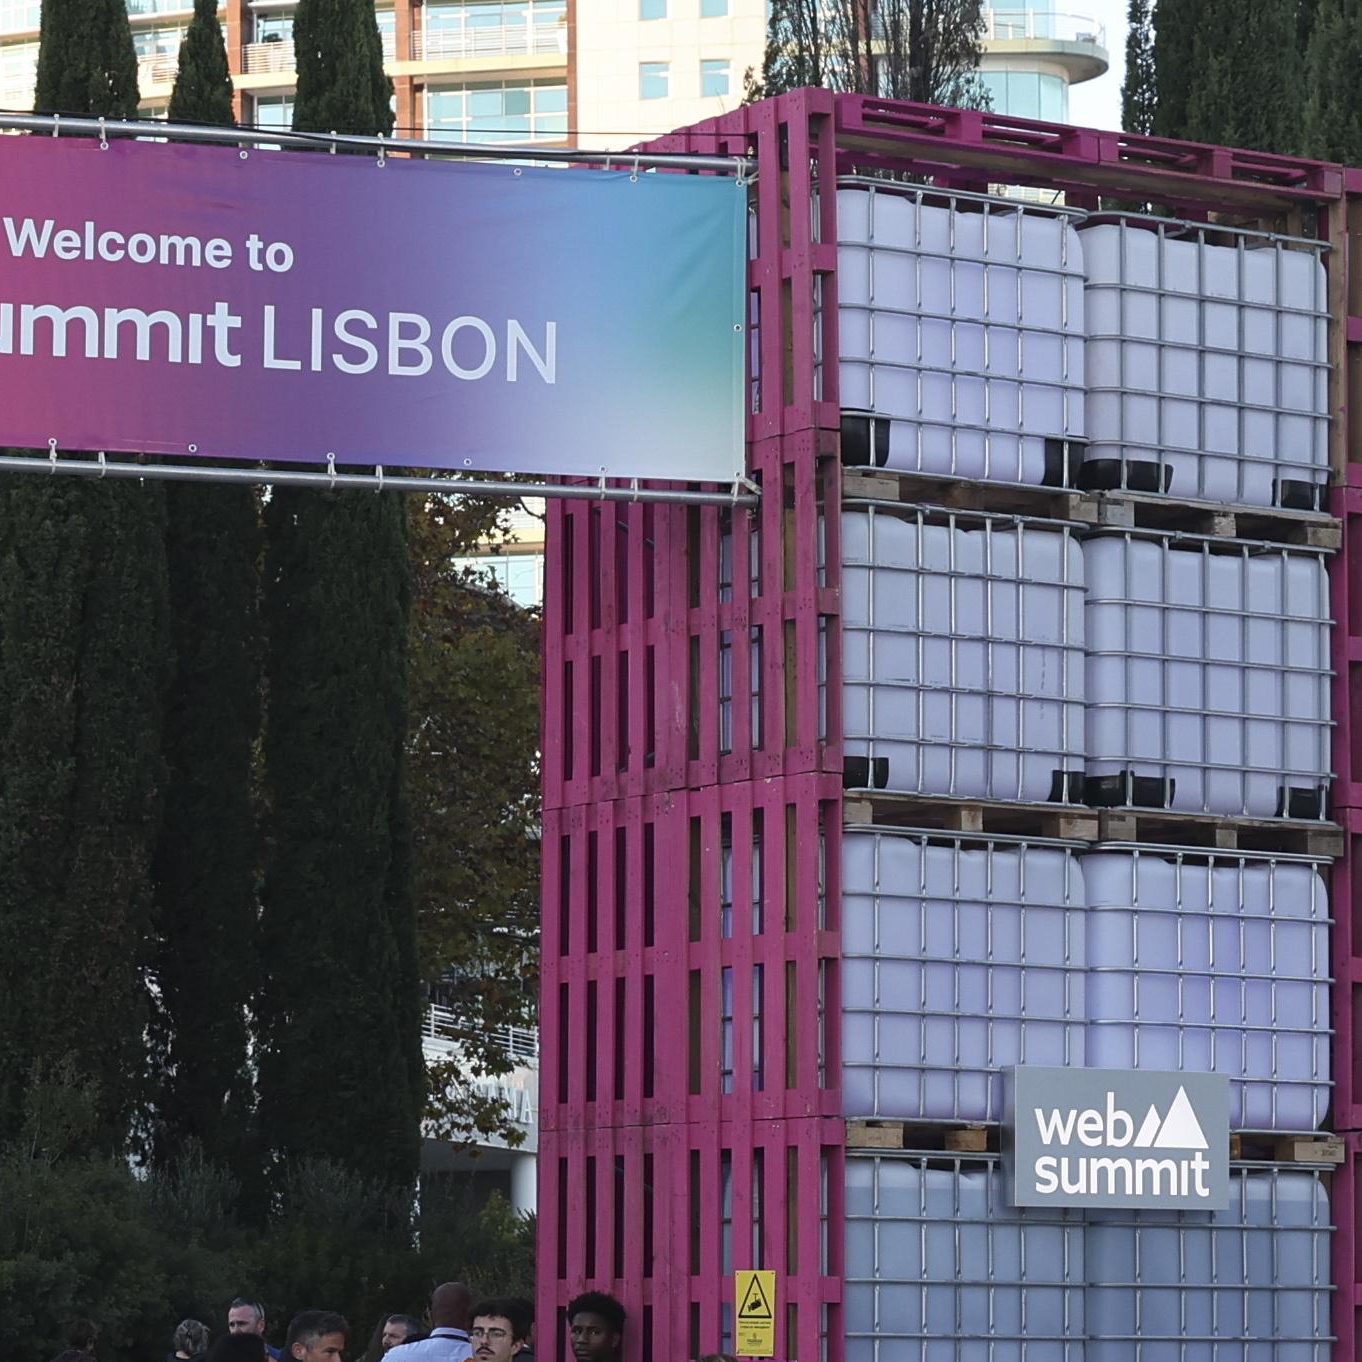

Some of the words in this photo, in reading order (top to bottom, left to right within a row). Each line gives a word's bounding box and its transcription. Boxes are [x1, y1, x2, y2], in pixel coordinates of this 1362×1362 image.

[2, 216, 233, 269] Welcome
[245, 233, 295, 273] to
[263, 304, 558, 385] LISBON
[1034, 1091, 1134, 1148] web
[1034, 1151, 1210, 1197] summit
